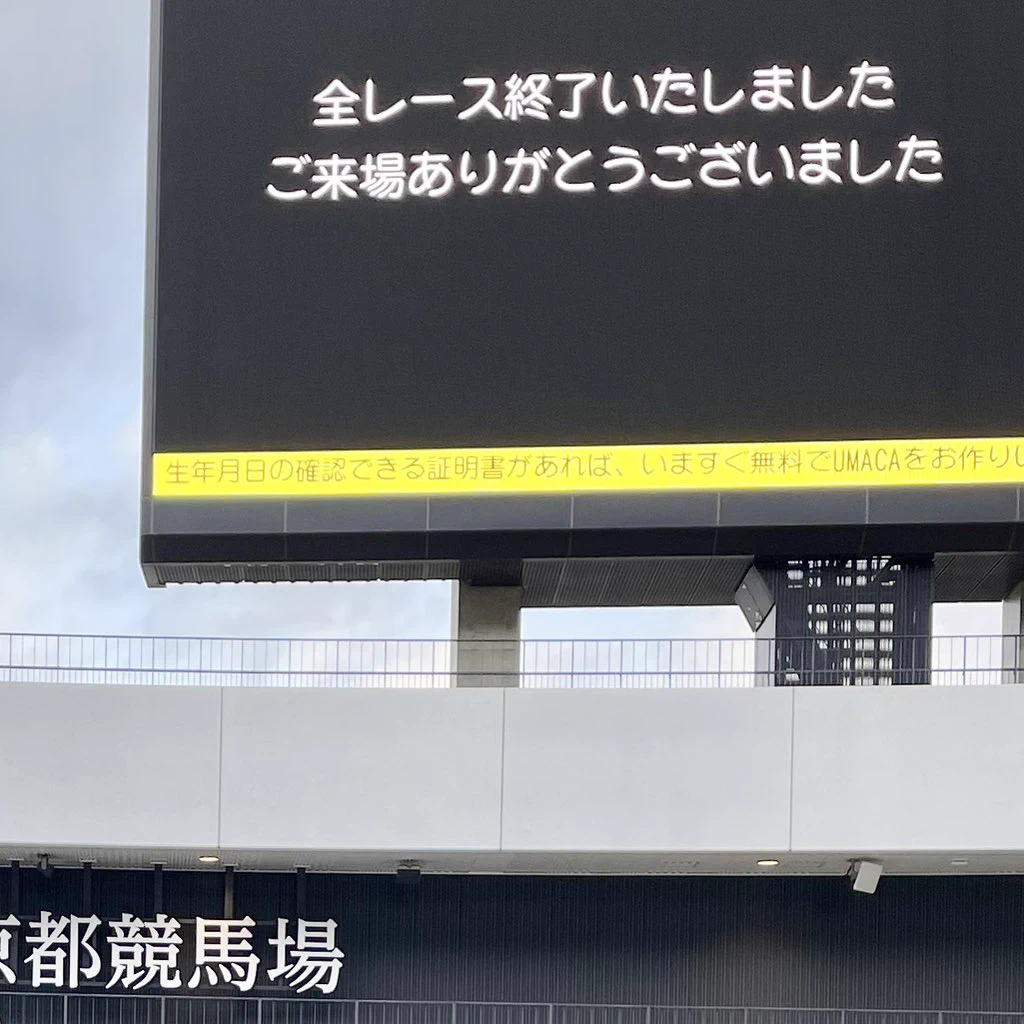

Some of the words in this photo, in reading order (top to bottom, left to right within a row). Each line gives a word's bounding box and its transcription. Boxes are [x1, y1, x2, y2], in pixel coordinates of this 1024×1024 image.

[312, 60, 896, 126] 全レース終了いたしました
[265, 135, 944, 200] ご来場ありがとうございました
